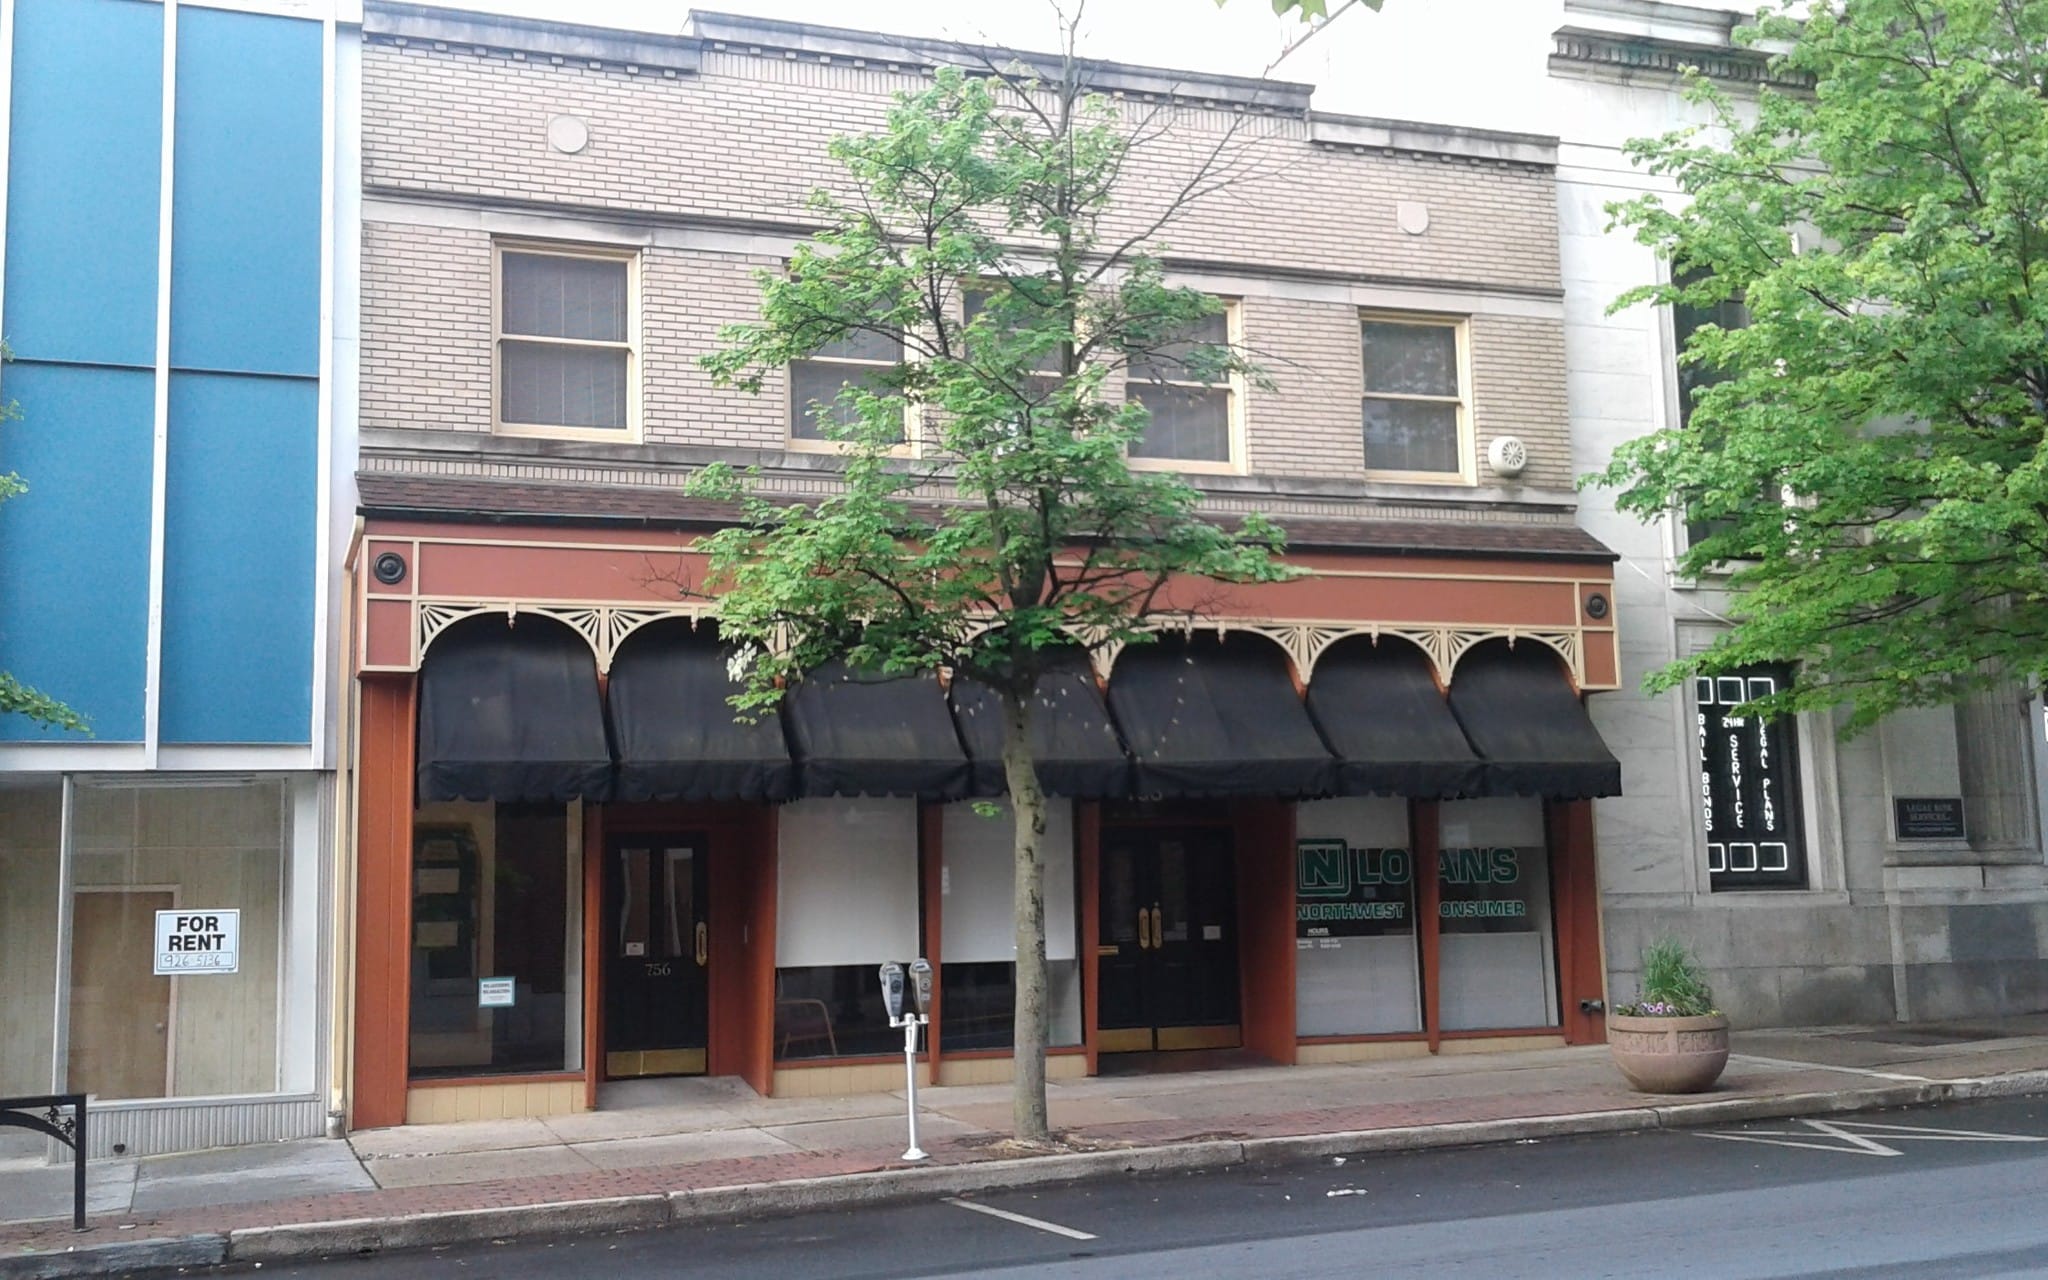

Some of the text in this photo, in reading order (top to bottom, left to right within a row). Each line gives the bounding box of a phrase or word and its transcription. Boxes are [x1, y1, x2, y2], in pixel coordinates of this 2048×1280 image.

[1697, 713, 1713, 831] BAIL BONDS
[1729, 734, 1744, 828] SERVICE
[1763, 778, 1775, 831] PLANS
[1300, 846, 1346, 889] N
[177, 916, 218, 932] FOR
[1296, 899, 1526, 920] NORTHWEST ONSUMER
[168, 934, 225, 951] RENT
